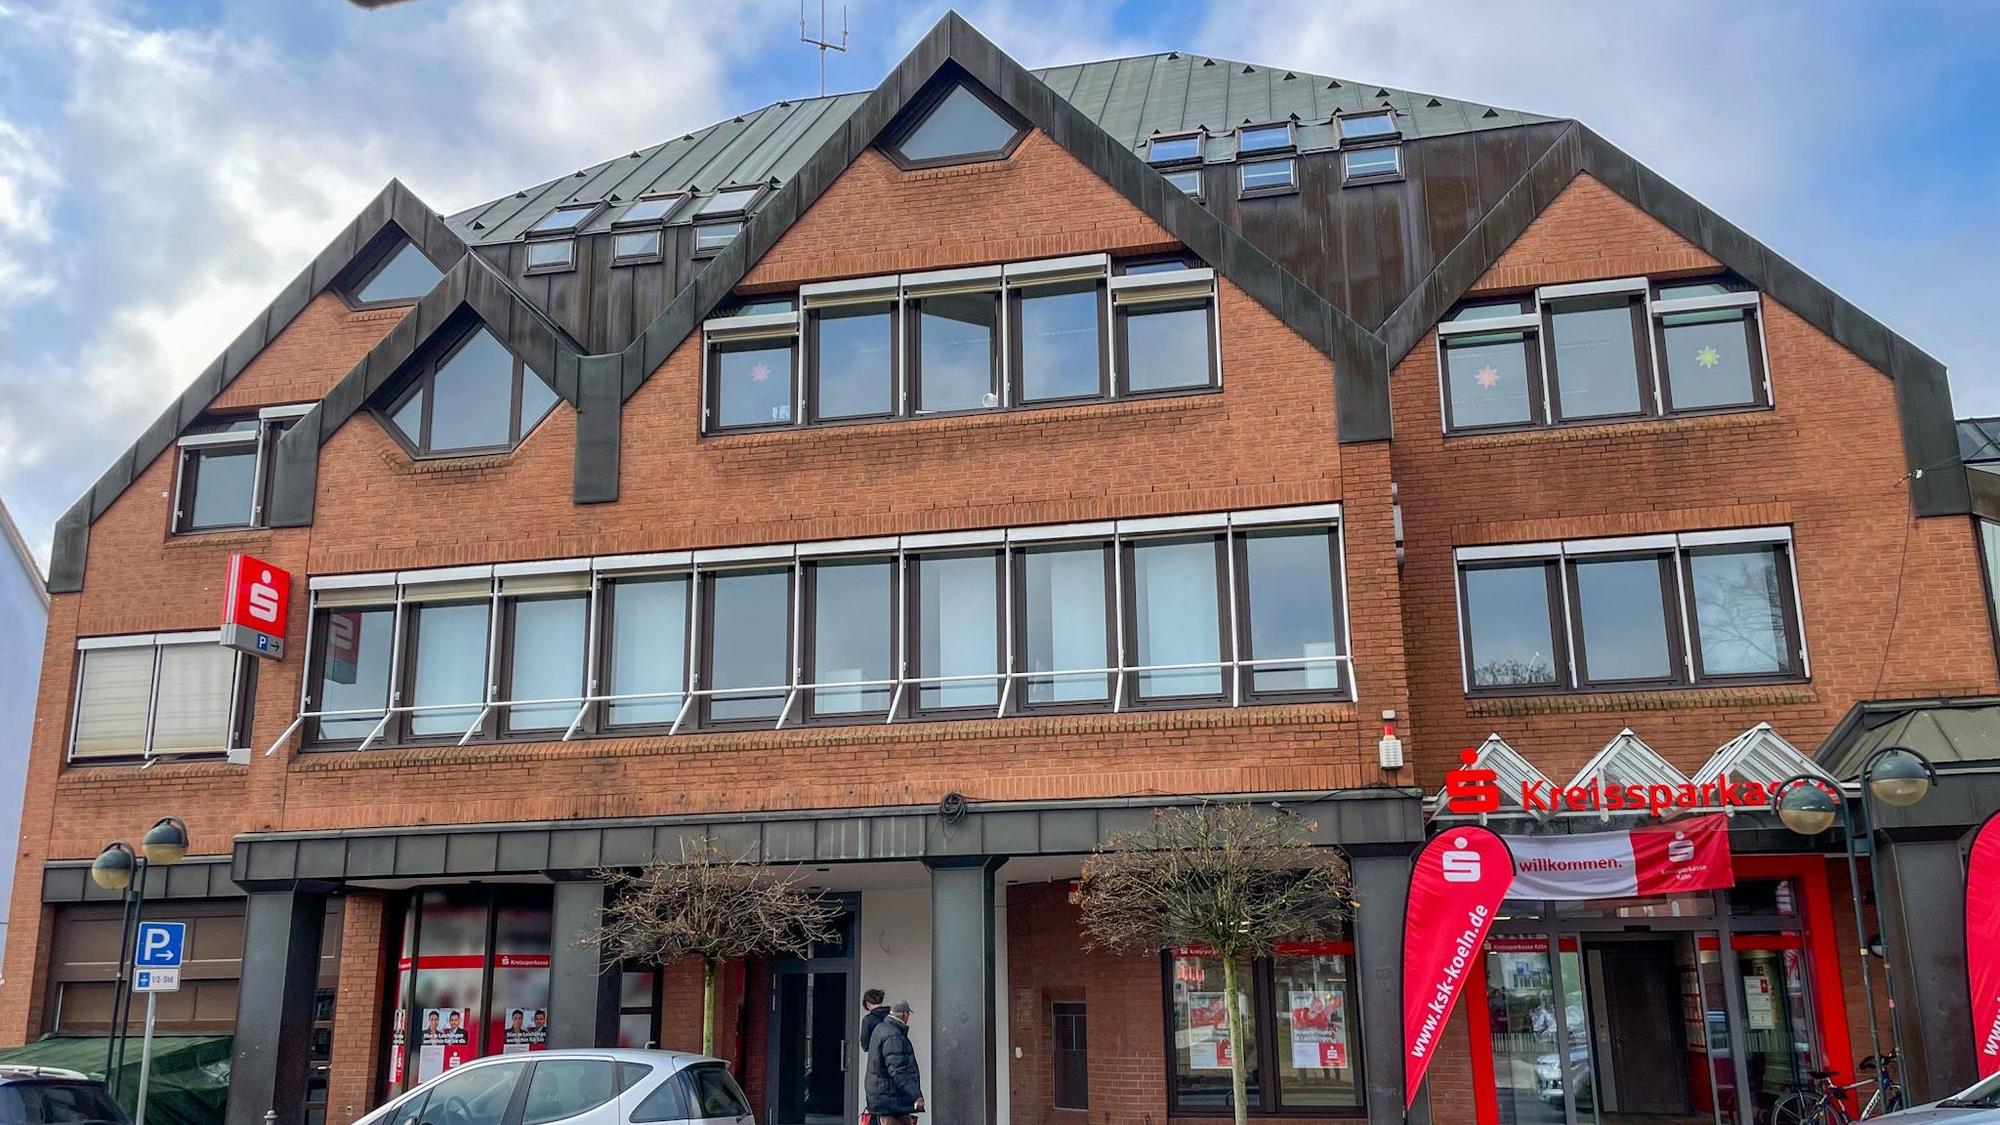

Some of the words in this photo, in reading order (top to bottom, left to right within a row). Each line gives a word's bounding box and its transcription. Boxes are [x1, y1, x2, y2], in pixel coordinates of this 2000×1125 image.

[1519, 858, 1623, 873] willkommen.
[144, 928, 171, 961] P
[1410, 904, 1489, 1059] www.ksk-koeln.de
